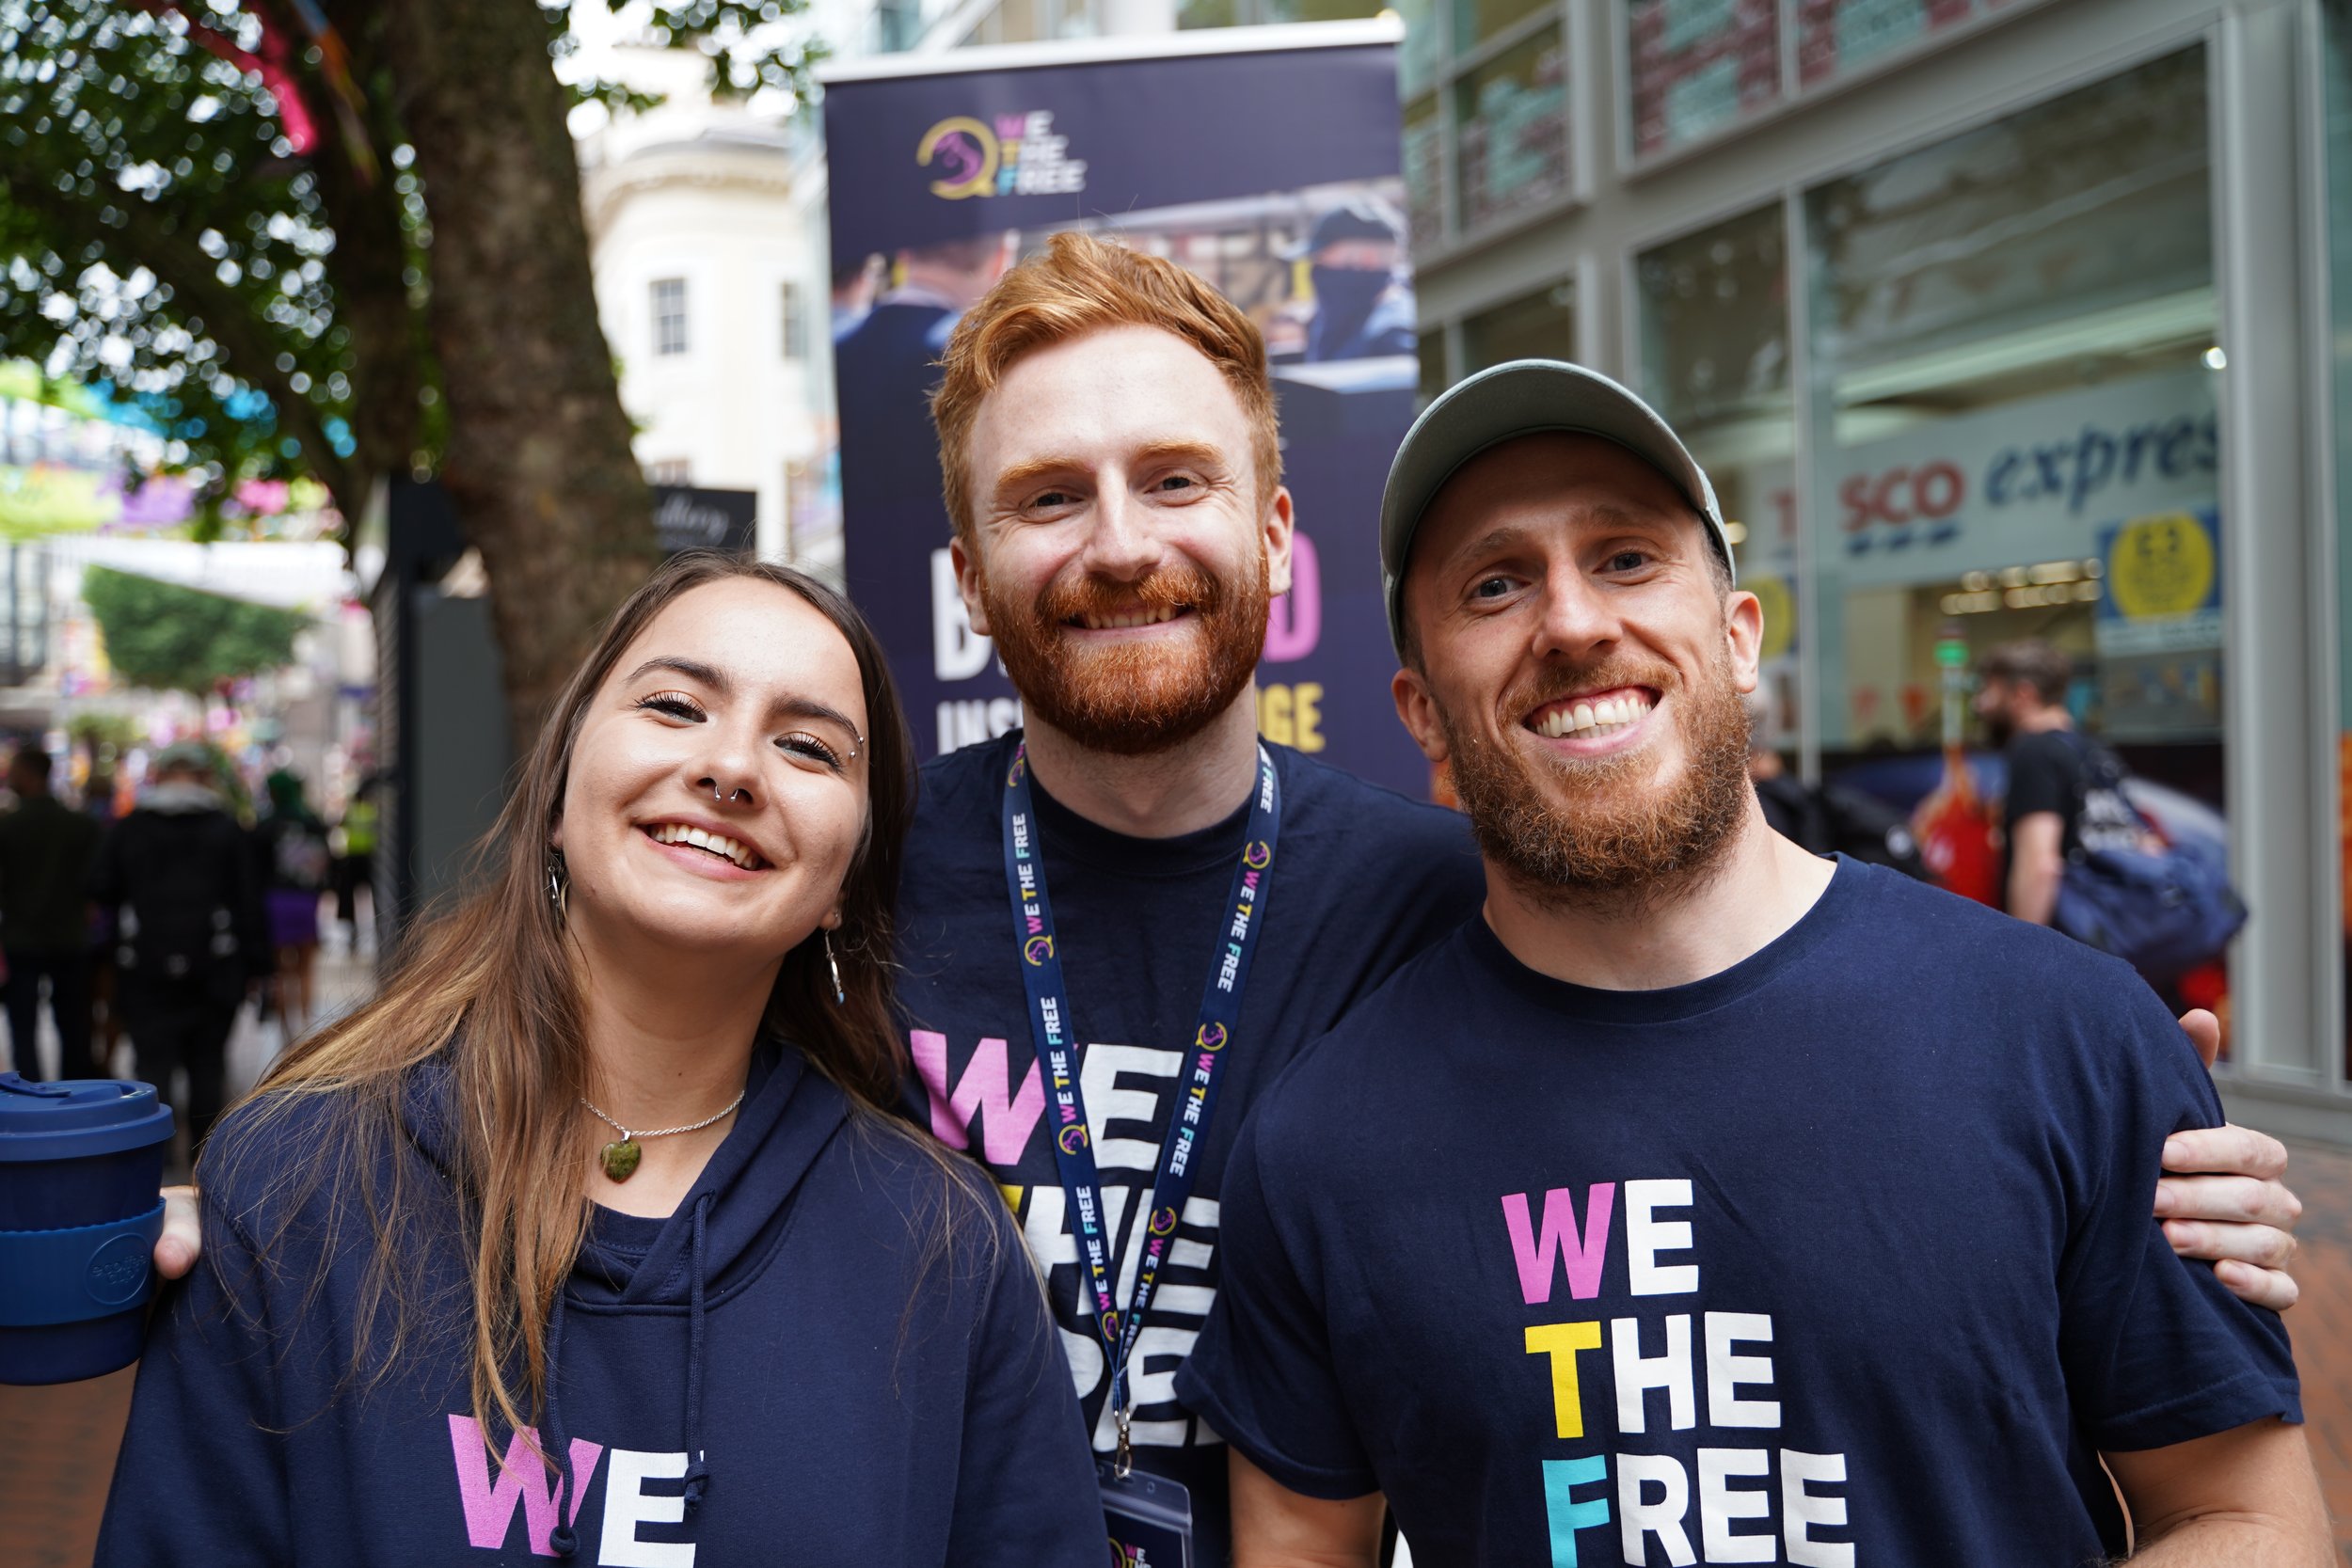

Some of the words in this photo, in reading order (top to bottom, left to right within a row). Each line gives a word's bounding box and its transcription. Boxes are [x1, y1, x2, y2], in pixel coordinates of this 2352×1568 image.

[995, 110, 1054, 139] WE
[1001, 135, 1070, 166] THE
[997, 160, 1088, 196] FREE
[1260, 767, 1274, 814] FREE
[1012, 813, 1030, 859] FREE
[1018, 863, 1038, 901] THE
[1240, 870, 1260, 902] WE
[1024, 903, 1043, 934] WE
[1231, 904, 1252, 941] THE
[1217, 942, 1242, 992] FREE
[1040, 996, 1063, 1046] FREE
[1050, 1050, 1071, 1089] THE
[1194, 1053, 1216, 1085] WE
[910, 1029, 1184, 1172] WE
[1057, 1091, 1077, 1123] WE
[1184, 1086, 1207, 1125] THE
[1168, 1126, 1196, 1178] FREE
[1075, 1185, 1098, 1235] FREE
[1000, 1185, 1220, 1316] HE
[1087, 1239, 1105, 1278] THE
[1146, 1239, 1166, 1270] WE
[1502, 1179, 1699, 1305] WE
[1095, 1279, 1111, 1310] WE
[1135, 1272, 1155, 1308] THE
[1524, 1311, 1781, 1438] THE
[448, 1414, 705, 1568] WE
[1542, 1448, 1855, 1568] FREE
[1126, 1544, 1146, 1562] WE
